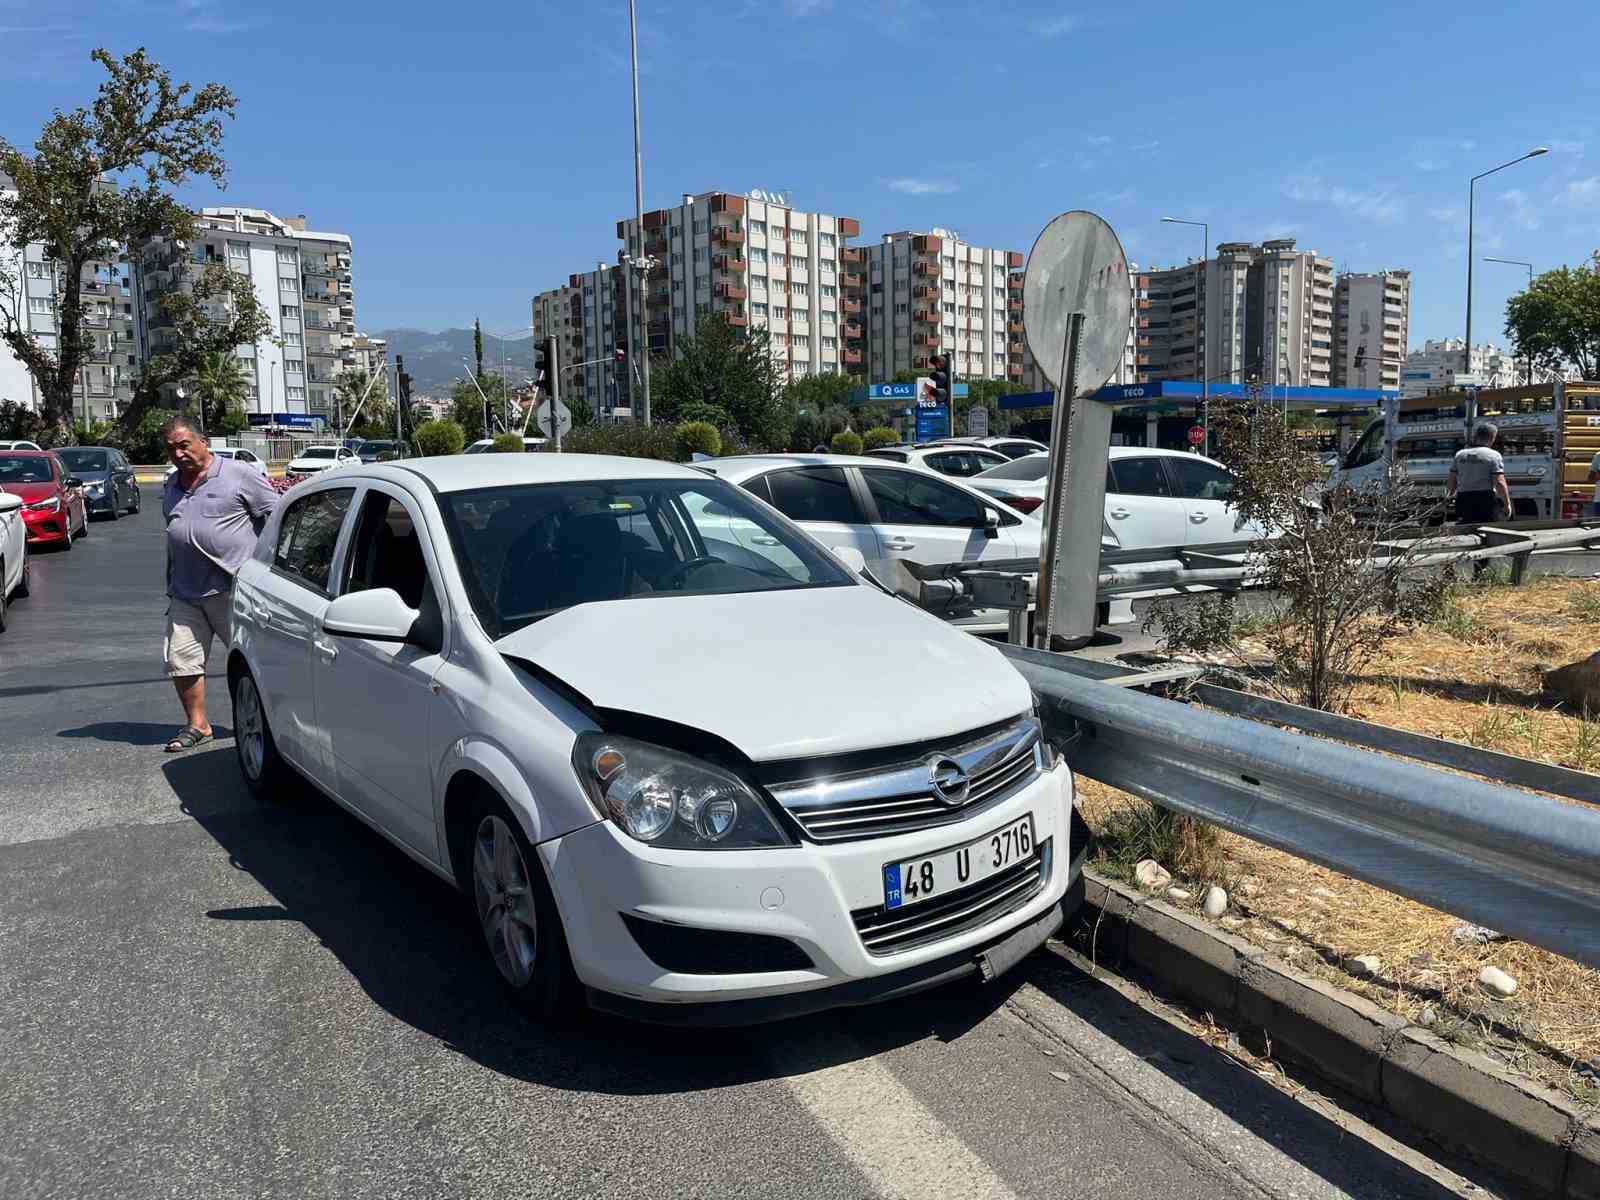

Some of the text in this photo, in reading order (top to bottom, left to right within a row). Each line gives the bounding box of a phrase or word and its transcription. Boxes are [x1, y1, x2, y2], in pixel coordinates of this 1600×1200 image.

[882, 386, 909, 395] Q GAS
[1123, 388, 1144, 397] TECO
[887, 823, 1030, 900] TR 48 U 3716
